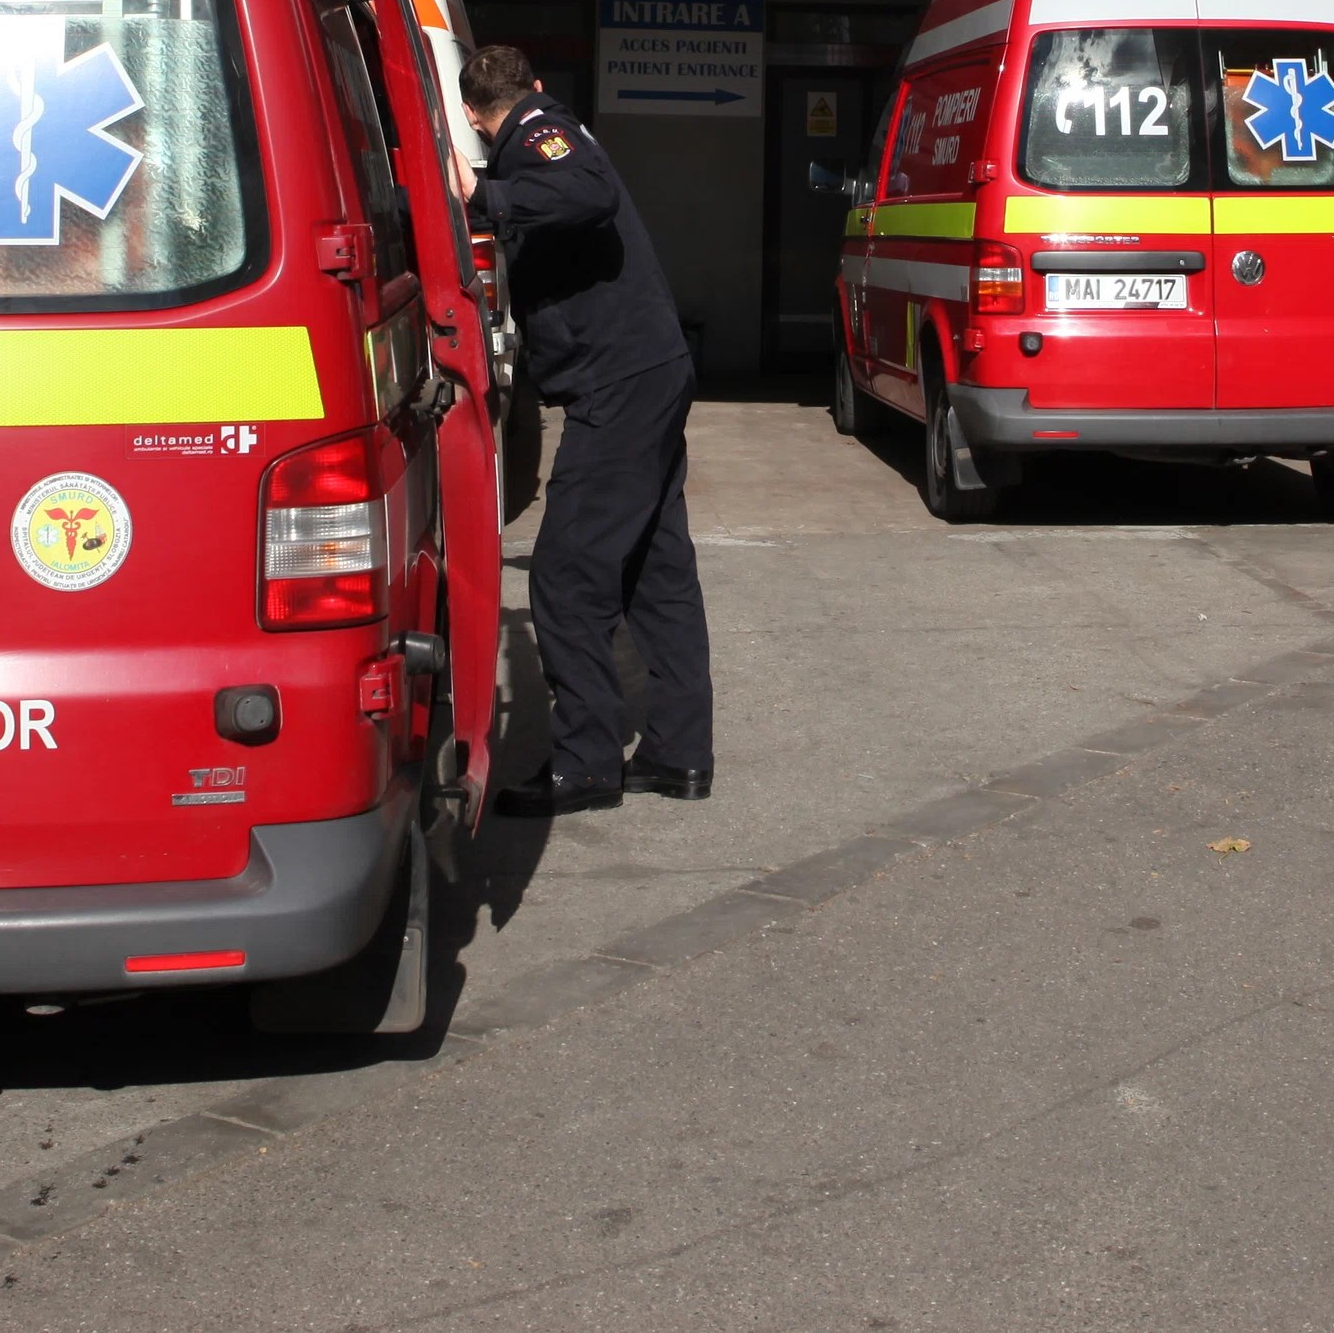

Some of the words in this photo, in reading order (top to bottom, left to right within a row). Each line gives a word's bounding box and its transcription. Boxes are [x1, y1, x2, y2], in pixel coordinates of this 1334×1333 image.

[613, 0, 726, 25] INTRARE
[733, 3, 751, 26] A
[619, 38, 670, 53] ACCES
[676, 40, 747, 55] PACIENTI
[607, 60, 672, 76] PATIENT
[677, 63, 759, 78] ENTRANCE
[932, 87, 981, 127] POMPIERII
[1083, 86, 1169, 136] 112
[932, 136, 960, 165] SMURD
[1065, 278, 1100, 300] MAI
[1114, 278, 1176, 300] 24717
[133, 434, 214, 446] deltamed
[25, 485, 57, 515] MINISTERUL
[50, 491, 94, 505] SMURD
[188, 766, 246, 787] TDI
